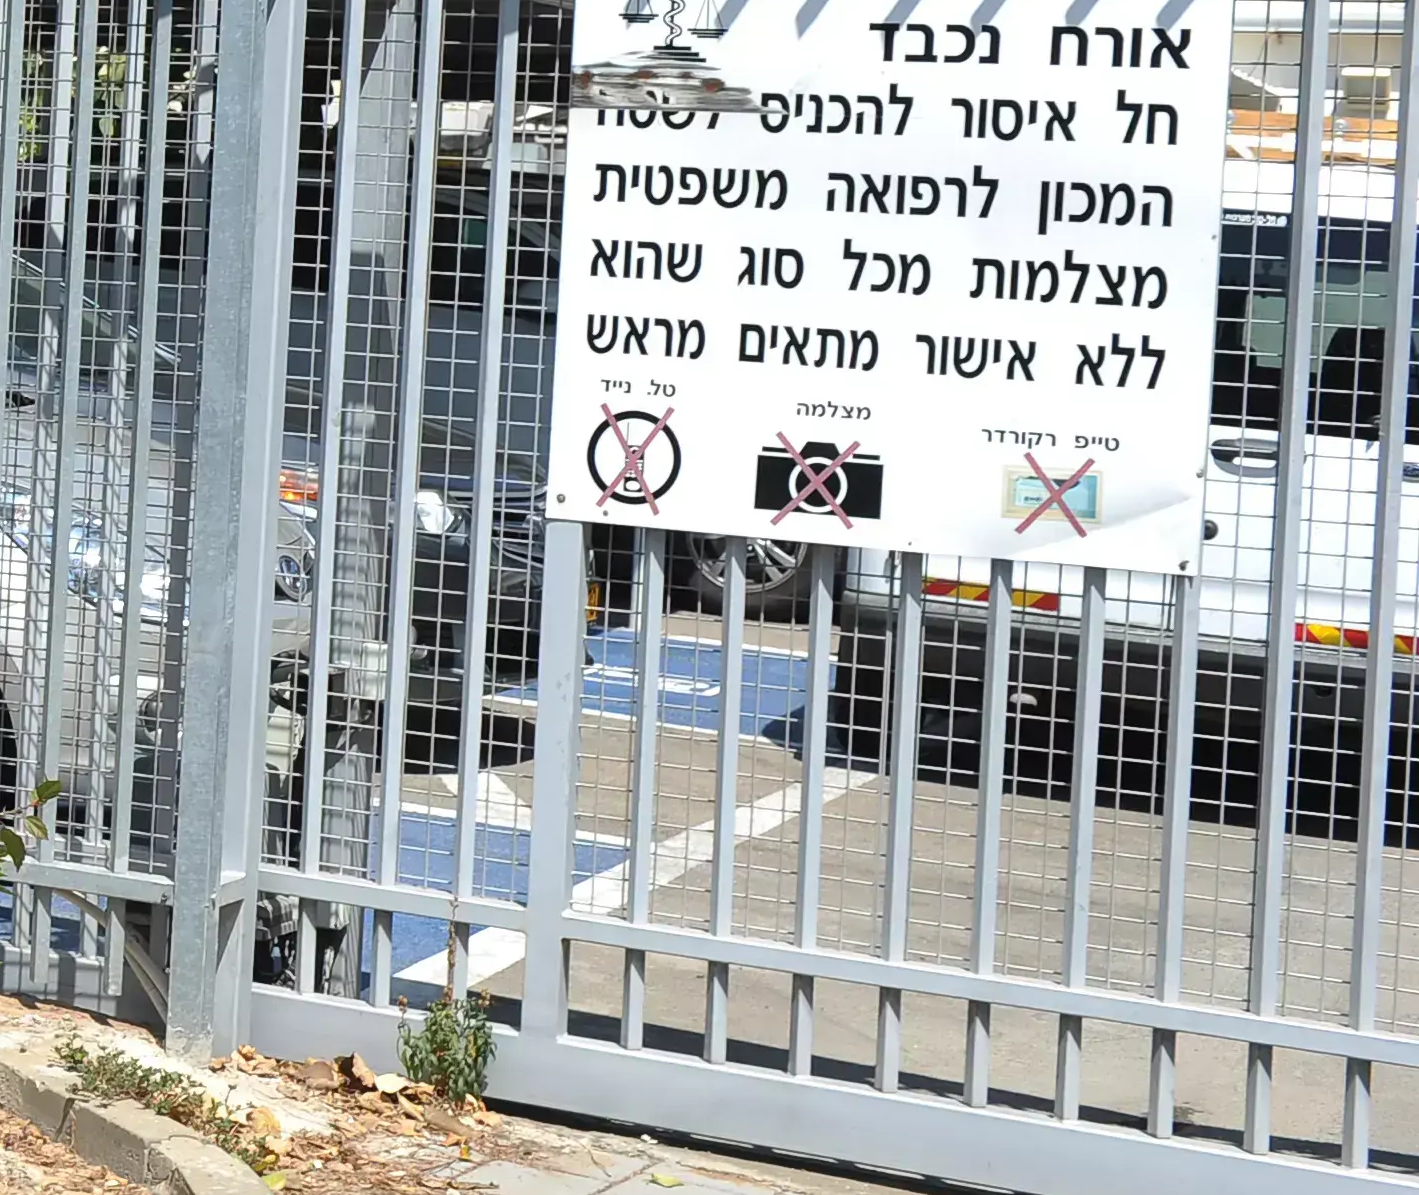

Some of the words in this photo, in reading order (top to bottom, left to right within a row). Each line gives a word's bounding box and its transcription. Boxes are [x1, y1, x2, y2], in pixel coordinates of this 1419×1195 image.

[869, 22, 1001, 64] נכבד
[1050, 26, 1191, 69] אורח
[760, 83, 914, 136] להכניס
[951, 98, 1076, 142] איסור
[1116, 89, 1178, 145] חל
[593, 163, 788, 211] משפטית
[826, 165, 999, 218] לרפואה
[1038, 180, 1173, 235] המכון
[590, 238, 703, 283] שהוא
[738, 246, 804, 289] סוג
[843, 238, 931, 296] מכל
[969, 249, 1168, 310] מצלמות
[586, 314, 705, 360] מראש
[738, 323, 879, 372] מתאים
[916, 334, 1036, 382] אישור
[1075, 333, 1166, 390] ללא
[600, 379, 632, 394] נייד
[647, 379, 676, 398] טל.
[796, 400, 872, 421] מצלמה
[981, 428, 1056, 450] רקורדר
[1074, 435, 1120, 452] טייפ
